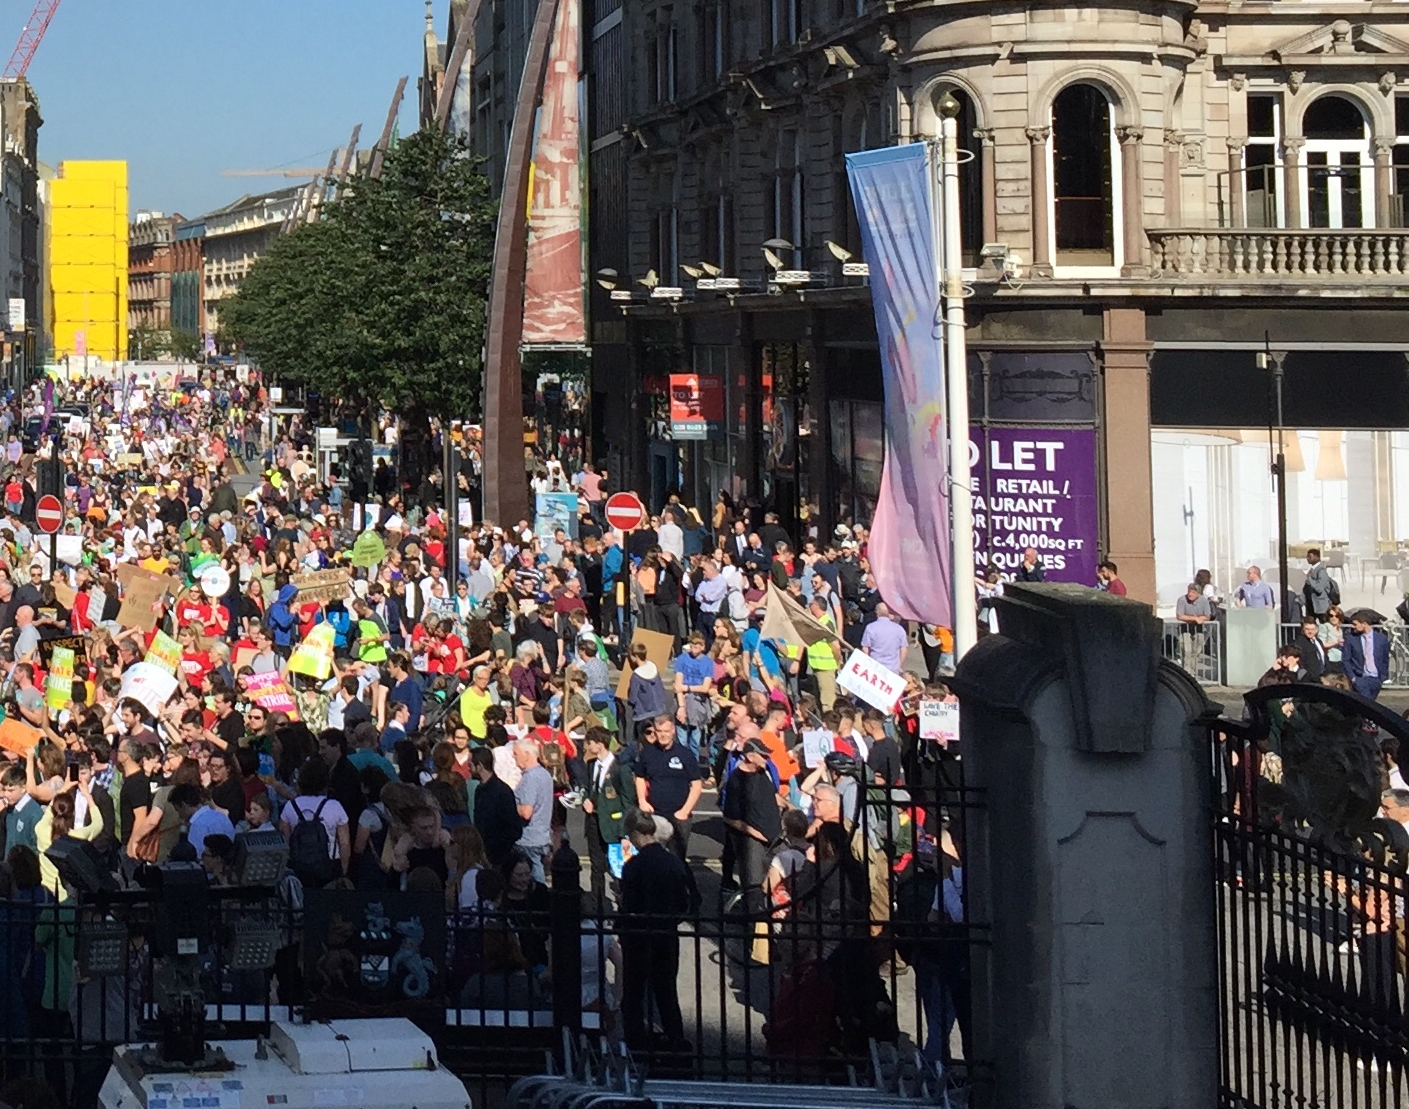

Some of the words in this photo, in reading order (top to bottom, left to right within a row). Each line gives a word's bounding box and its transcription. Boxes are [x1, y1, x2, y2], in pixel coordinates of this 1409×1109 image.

[991, 440, 1065, 471] LET
[996, 478, 1060, 495] RETAIL
[971, 495, 1056, 514] TAURANT
[1068, 539, 1084, 550] FT
[43, 636, 84, 652] RESPECT
[260, 693, 290, 706] STRIKE
